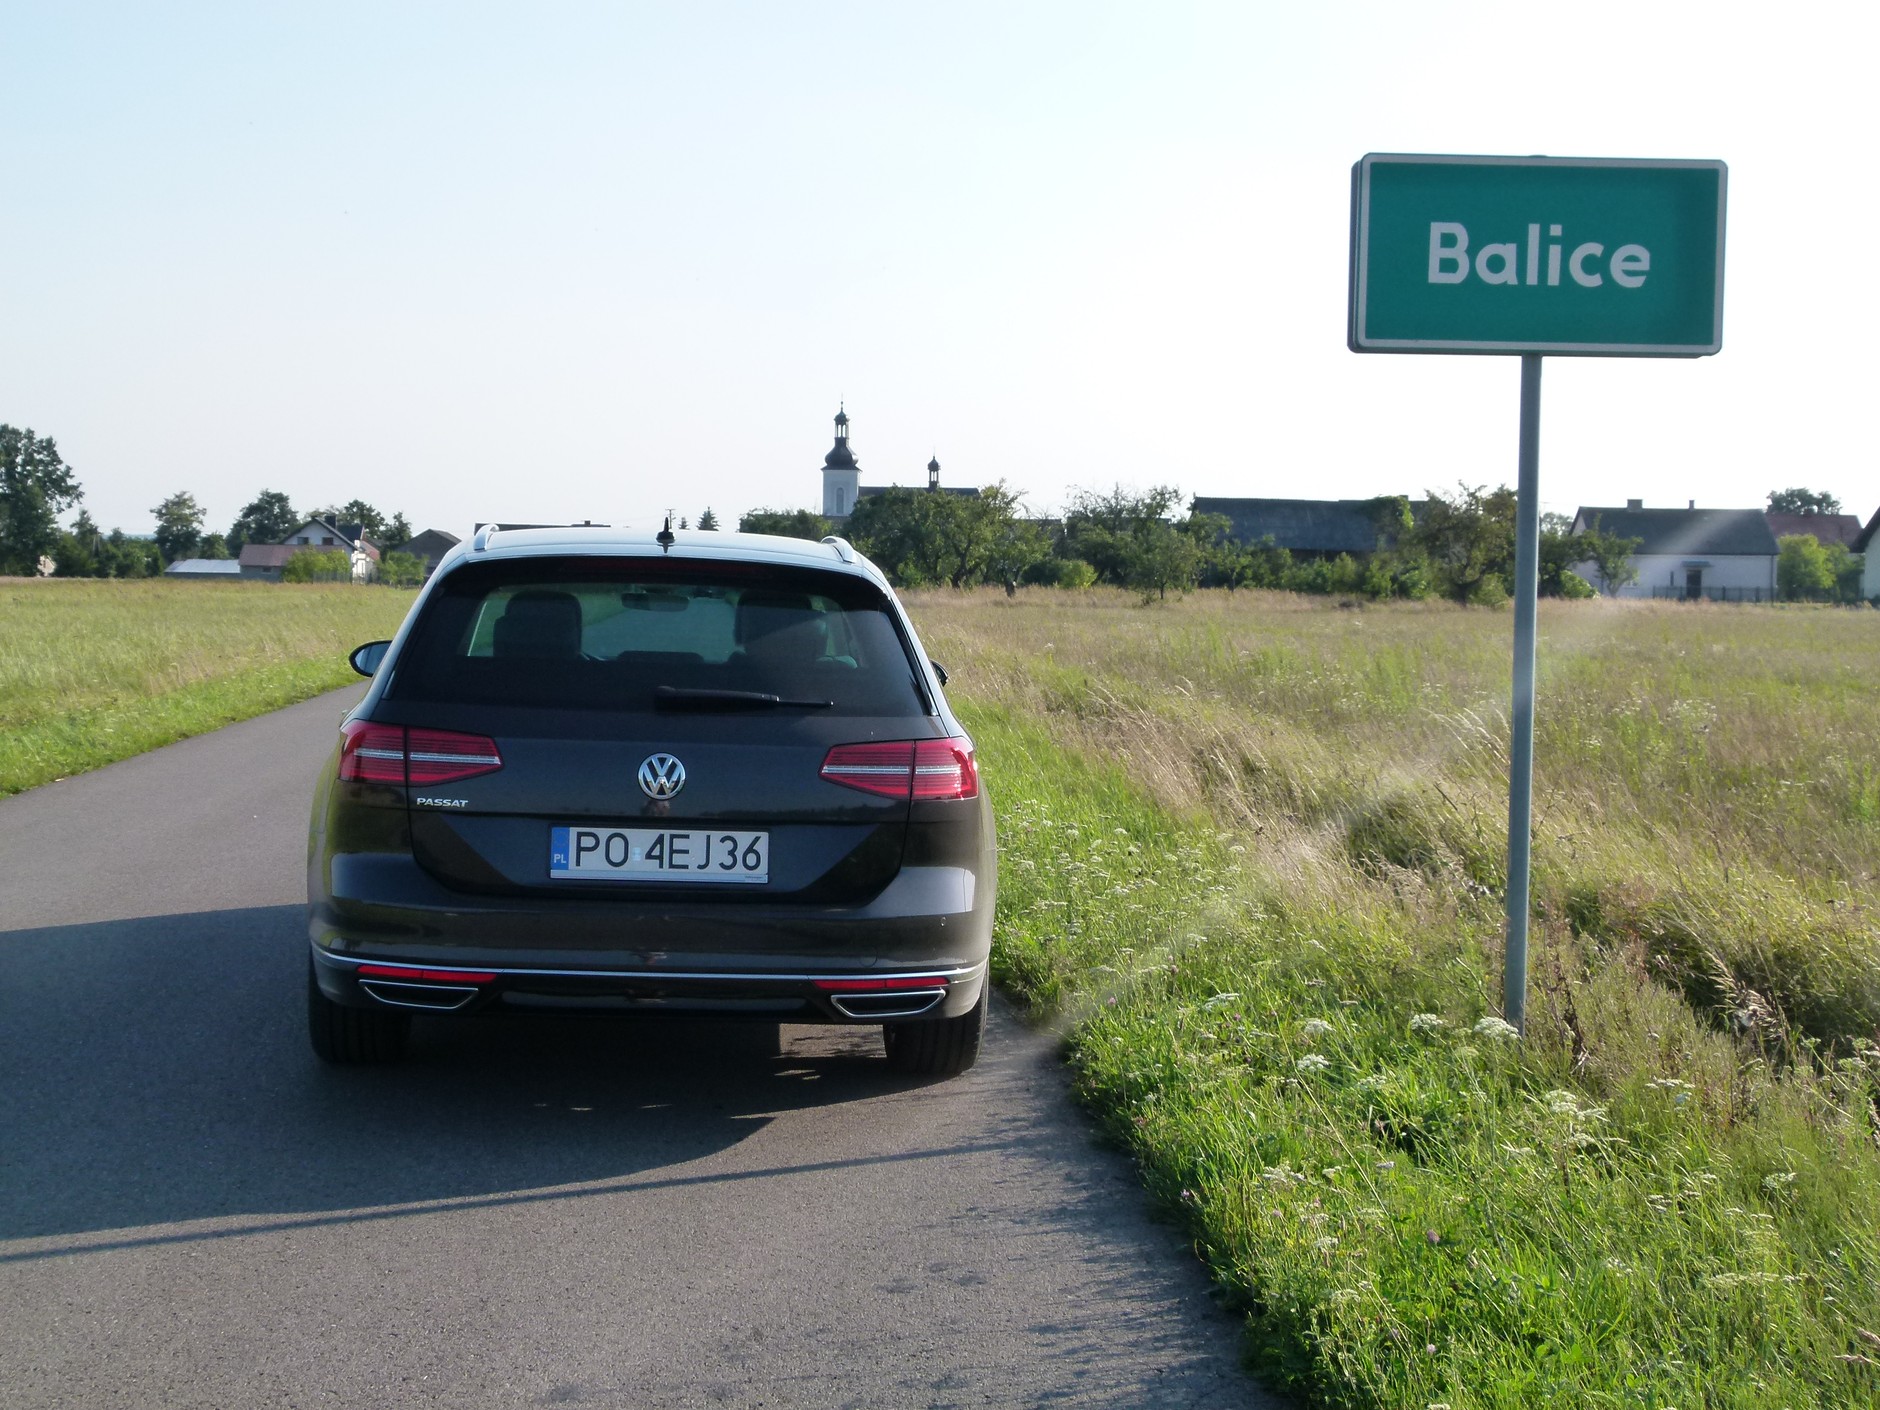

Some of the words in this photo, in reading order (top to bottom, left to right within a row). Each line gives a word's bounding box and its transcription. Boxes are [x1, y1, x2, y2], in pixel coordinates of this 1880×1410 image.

[1428, 222, 1651, 288] Balice
[416, 797, 469, 808] PASSAT
[553, 853, 567, 864] PL
[576, 831, 629, 868] PO
[645, 834, 762, 871] 4EJ36
